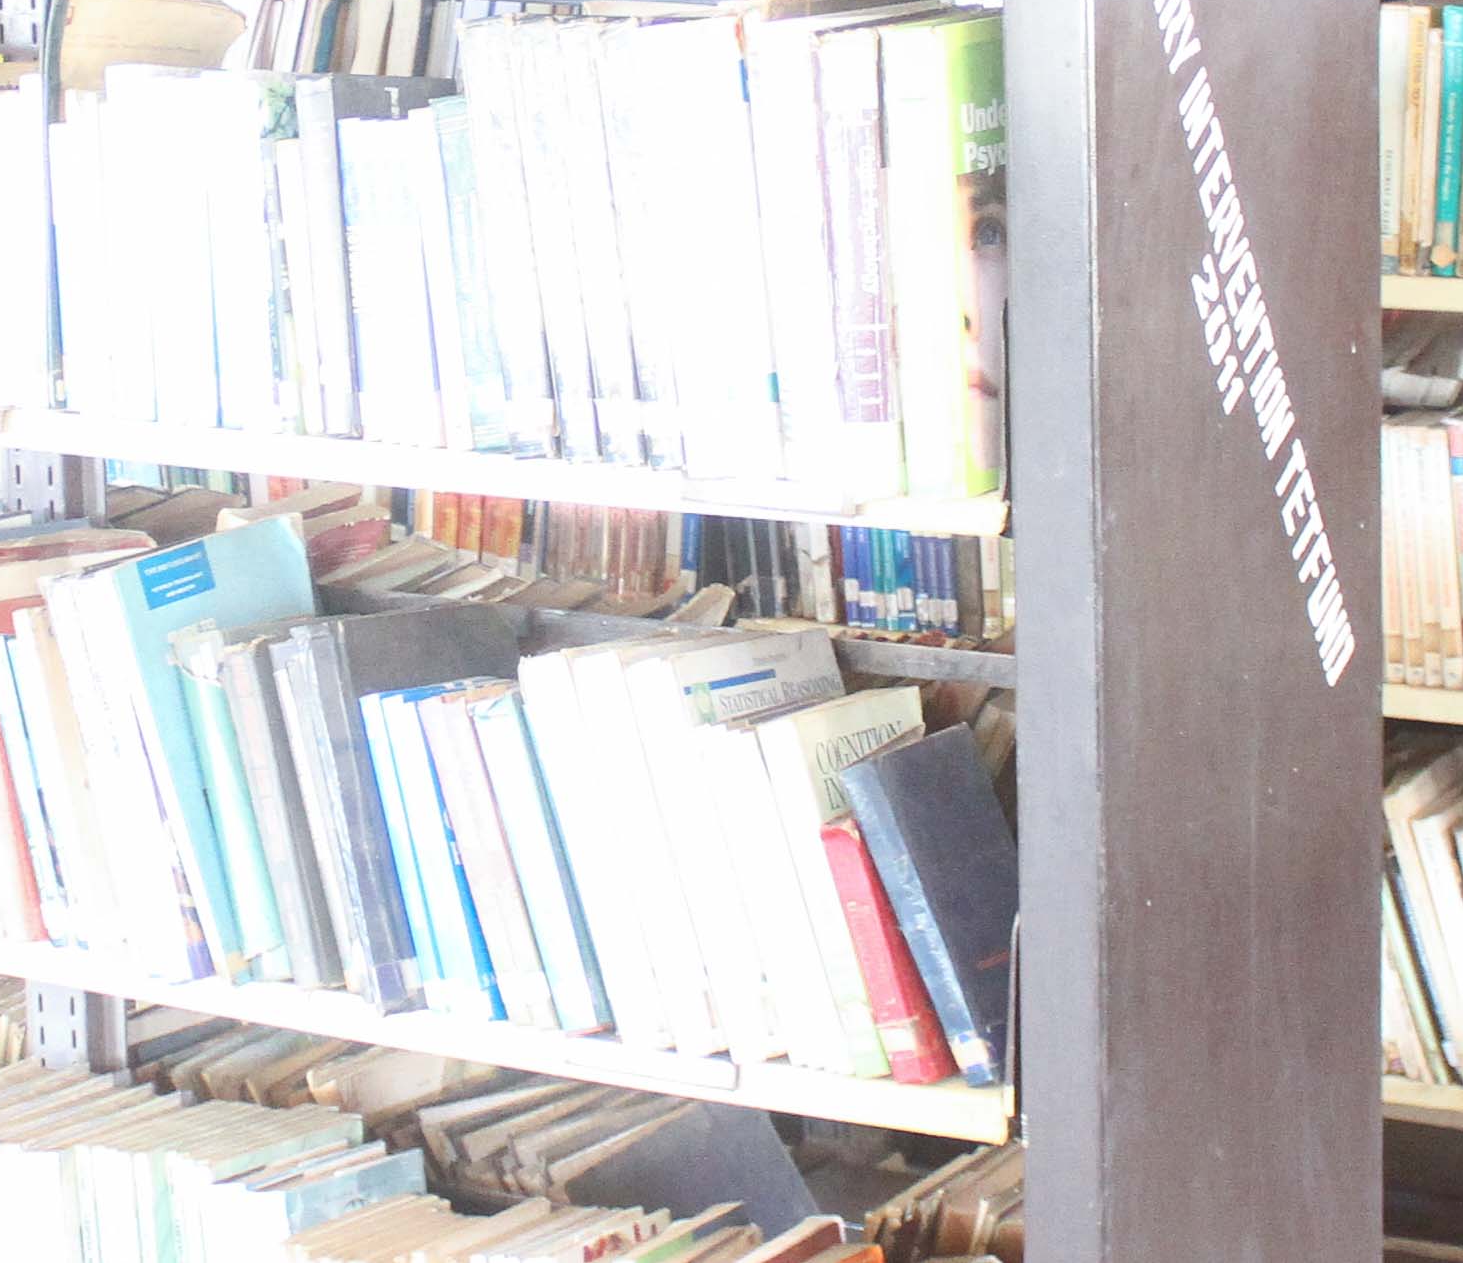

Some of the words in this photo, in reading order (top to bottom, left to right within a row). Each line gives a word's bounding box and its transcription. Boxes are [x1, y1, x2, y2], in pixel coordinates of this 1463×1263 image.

[1179, 67, 1295, 463] INTERVENTION
[1274, 438, 1358, 688] TETFUND
[1189, 264, 1245, 416] 2011
[718, 683, 777, 717] STATISTICAL
[780, 673, 842, 701] REASONING
